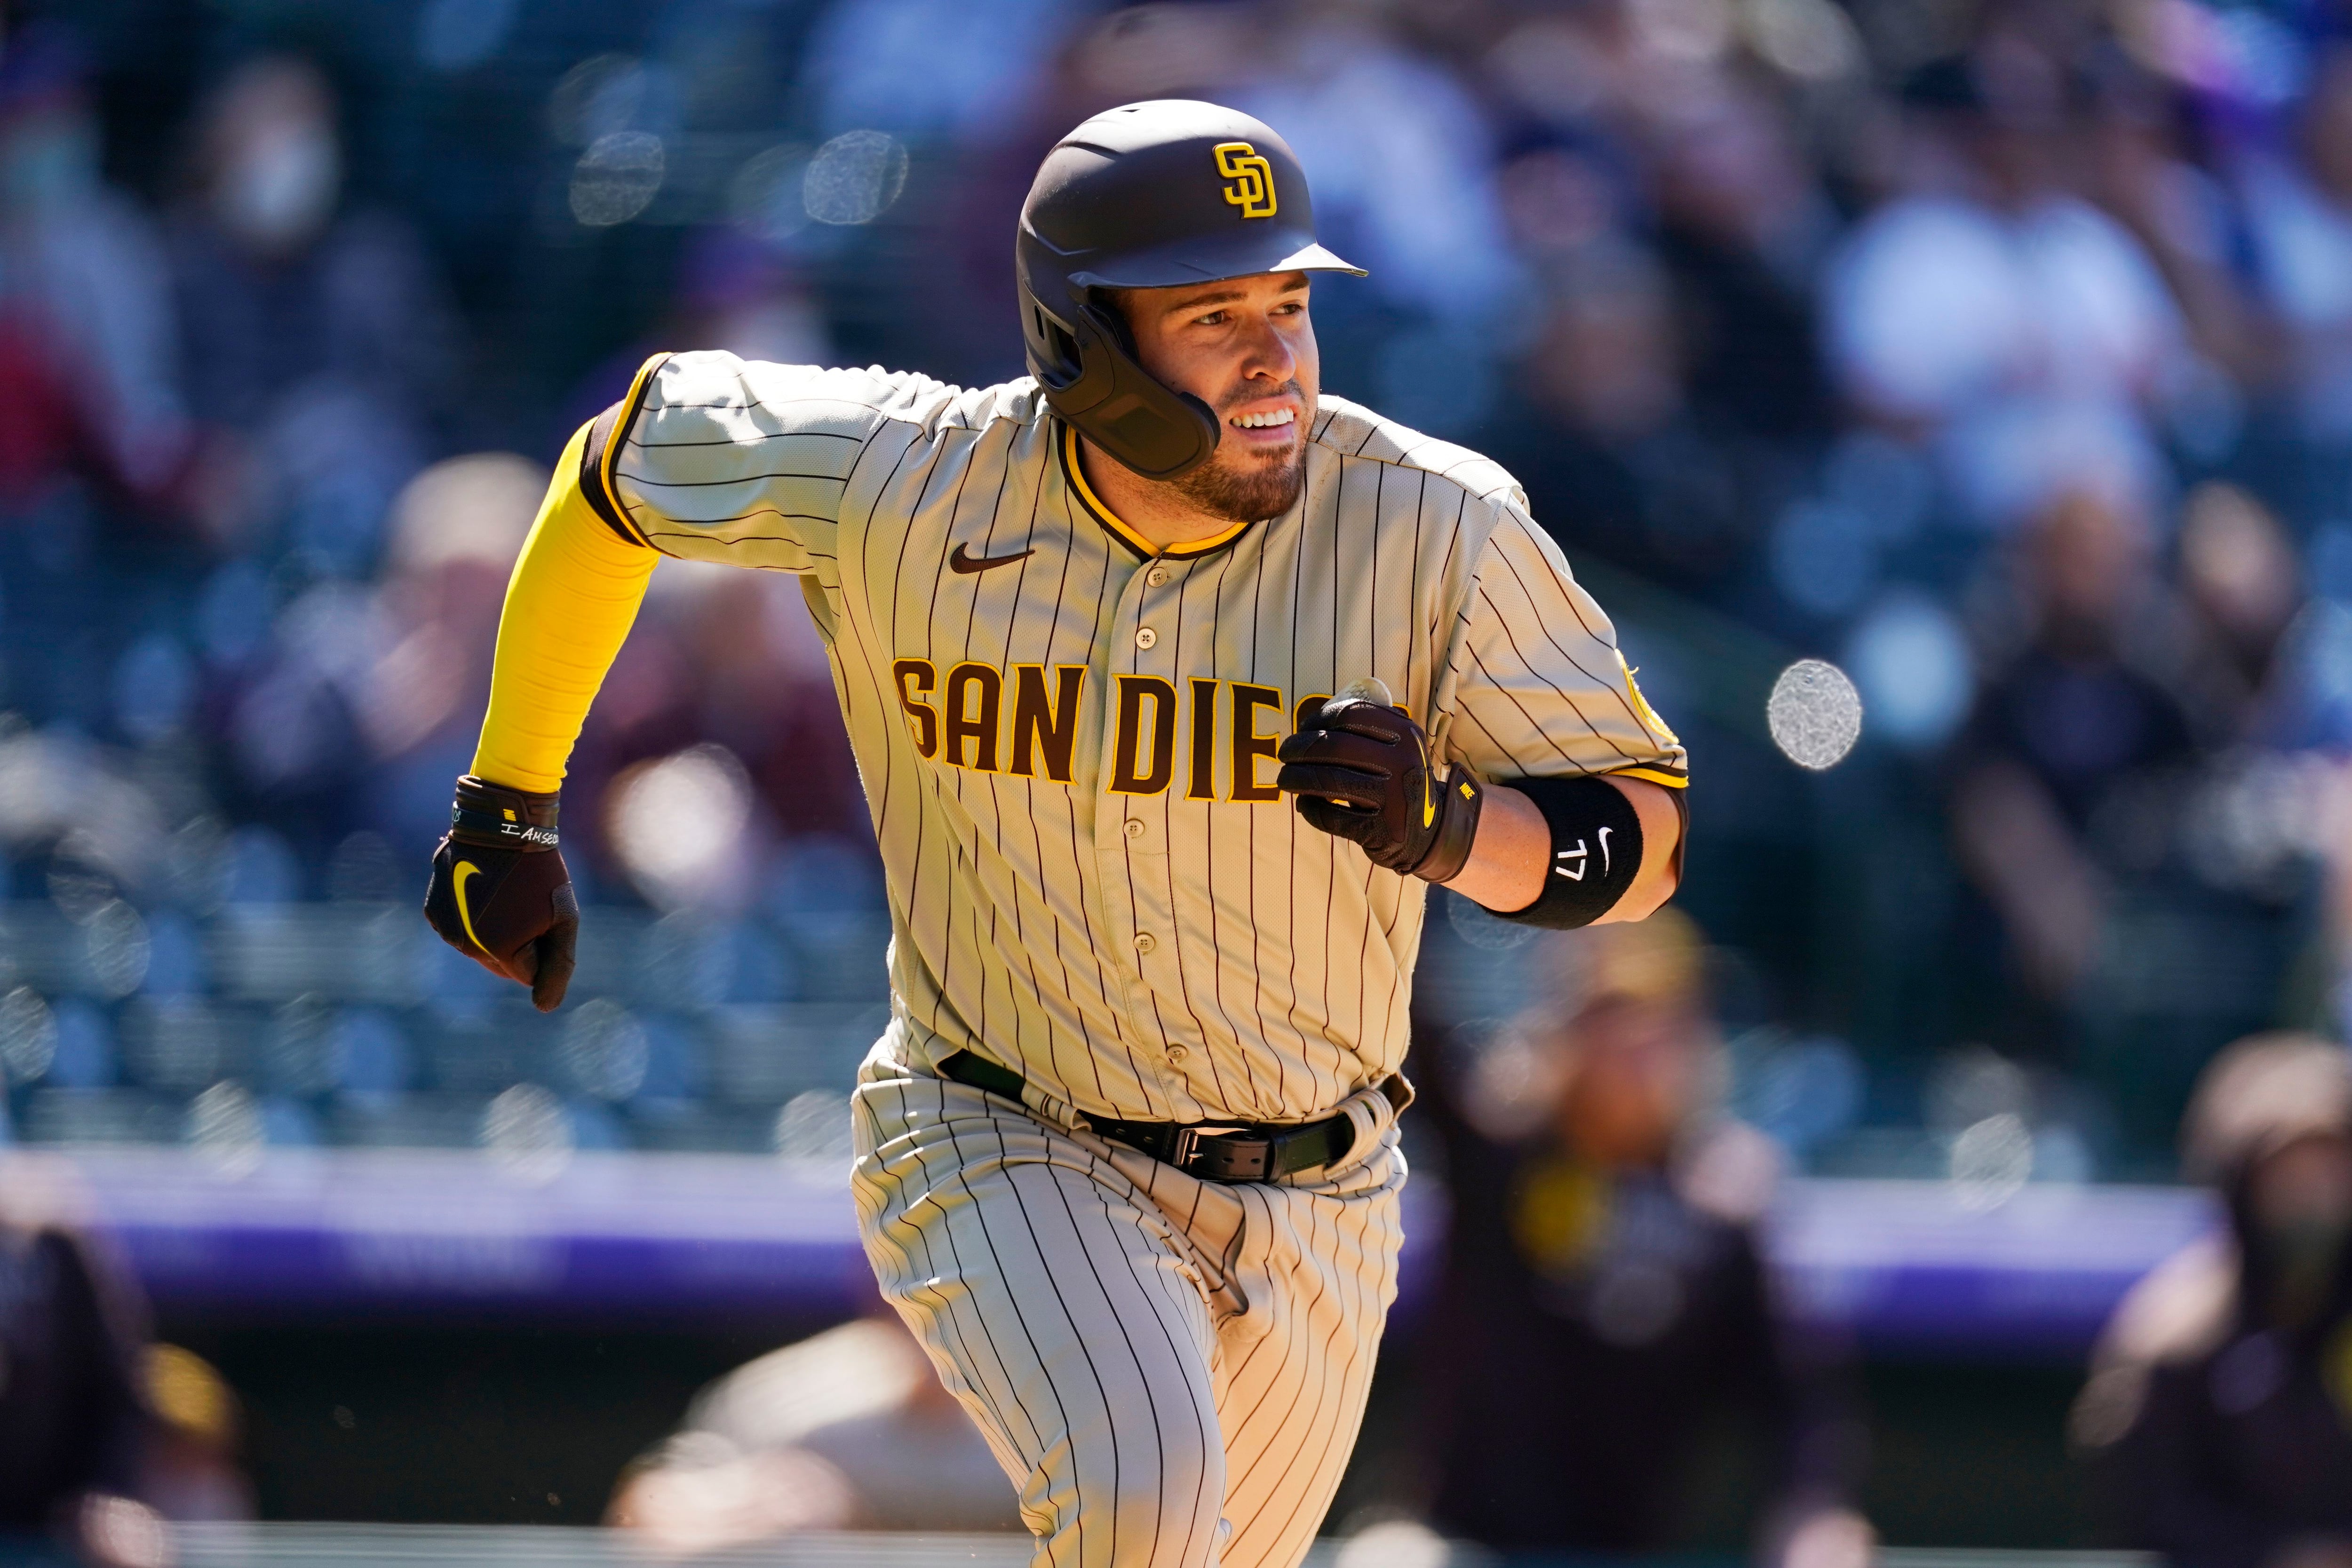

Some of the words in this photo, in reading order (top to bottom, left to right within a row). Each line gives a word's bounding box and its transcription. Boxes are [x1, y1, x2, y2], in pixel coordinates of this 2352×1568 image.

[1212, 142, 1277, 219] SD
[892, 657, 1088, 785] SAN
[1105, 673, 1412, 805] DIE
[1459, 782, 1475, 800] NIKE
[501, 823, 520, 835] I
[1556, 839, 1588, 881] 17
